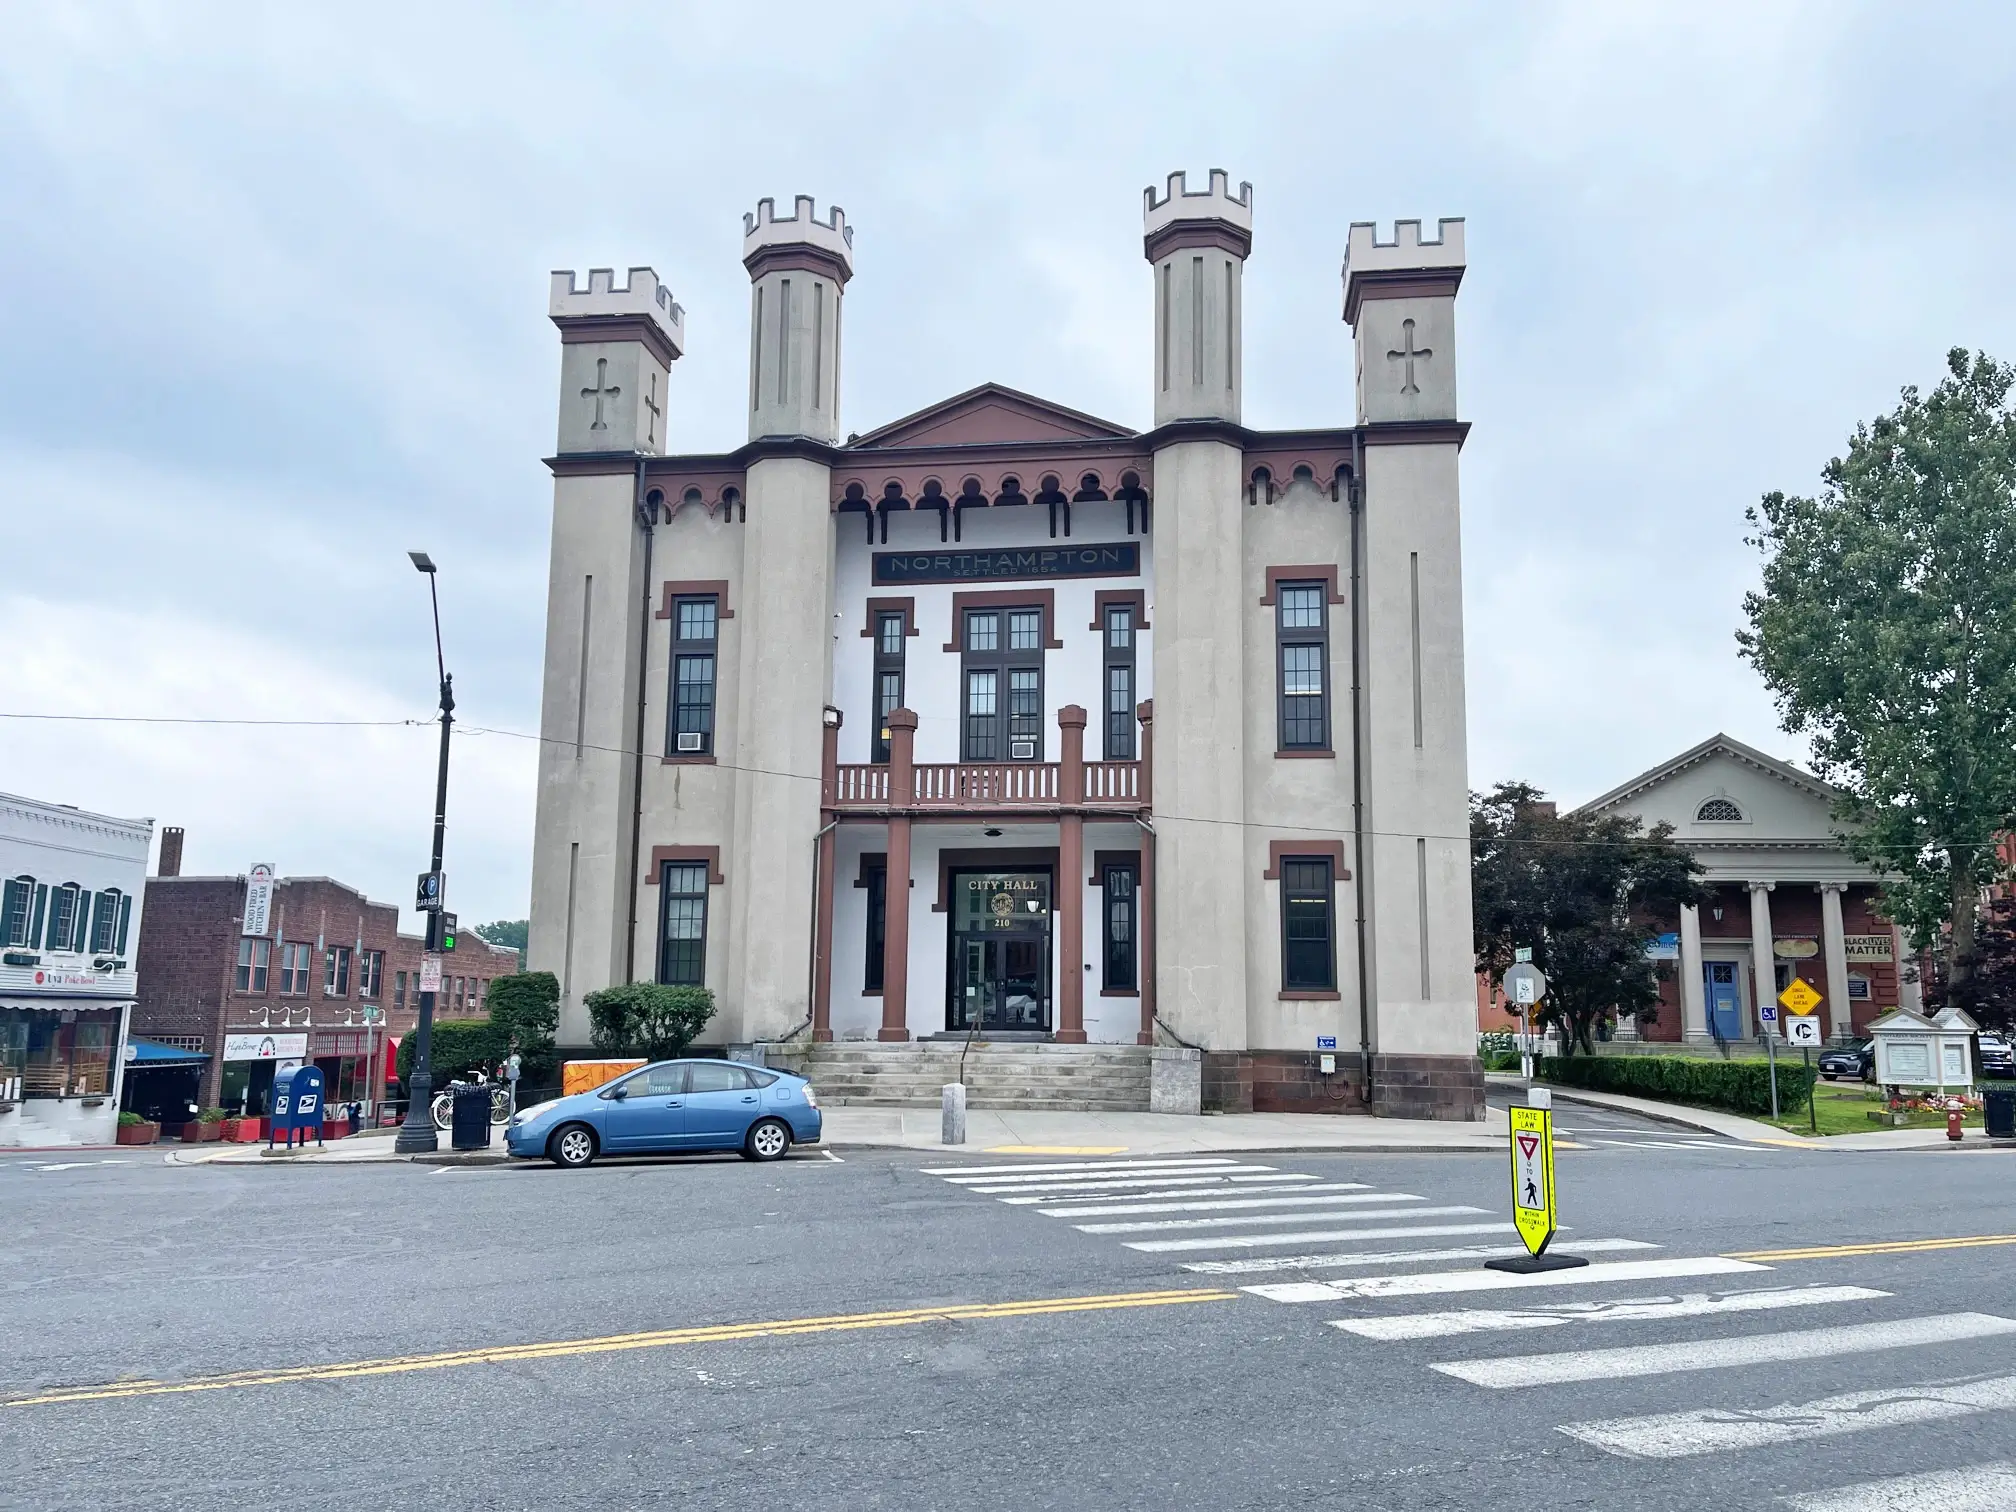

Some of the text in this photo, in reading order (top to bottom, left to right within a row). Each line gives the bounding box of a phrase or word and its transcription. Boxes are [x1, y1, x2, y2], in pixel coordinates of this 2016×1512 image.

[891, 549, 1120, 572] NORTHAMPTON
[953, 565, 1058, 577] SETTLED 1654
[968, 880, 1038, 890] CITY HALL
[416, 897, 438, 907] GARAGE
[246, 889, 258, 931] WOOD FIRED
[255, 905, 265, 934] KITCHEN
[994, 919, 1010, 927] 210
[1844, 937, 1890, 945] BLACK LIVES
[1845, 946, 1892, 955] MATTER
[64, 974, 79, 984] Poke
[80, 976, 96, 985] Bowl
[1517, 1111, 1537, 1121] STATE
[1520, 1121, 1535, 1129] LAW
[1526, 1168, 1533, 1176] TO
[1518, 1217, 1546, 1227] CROSSWALK
